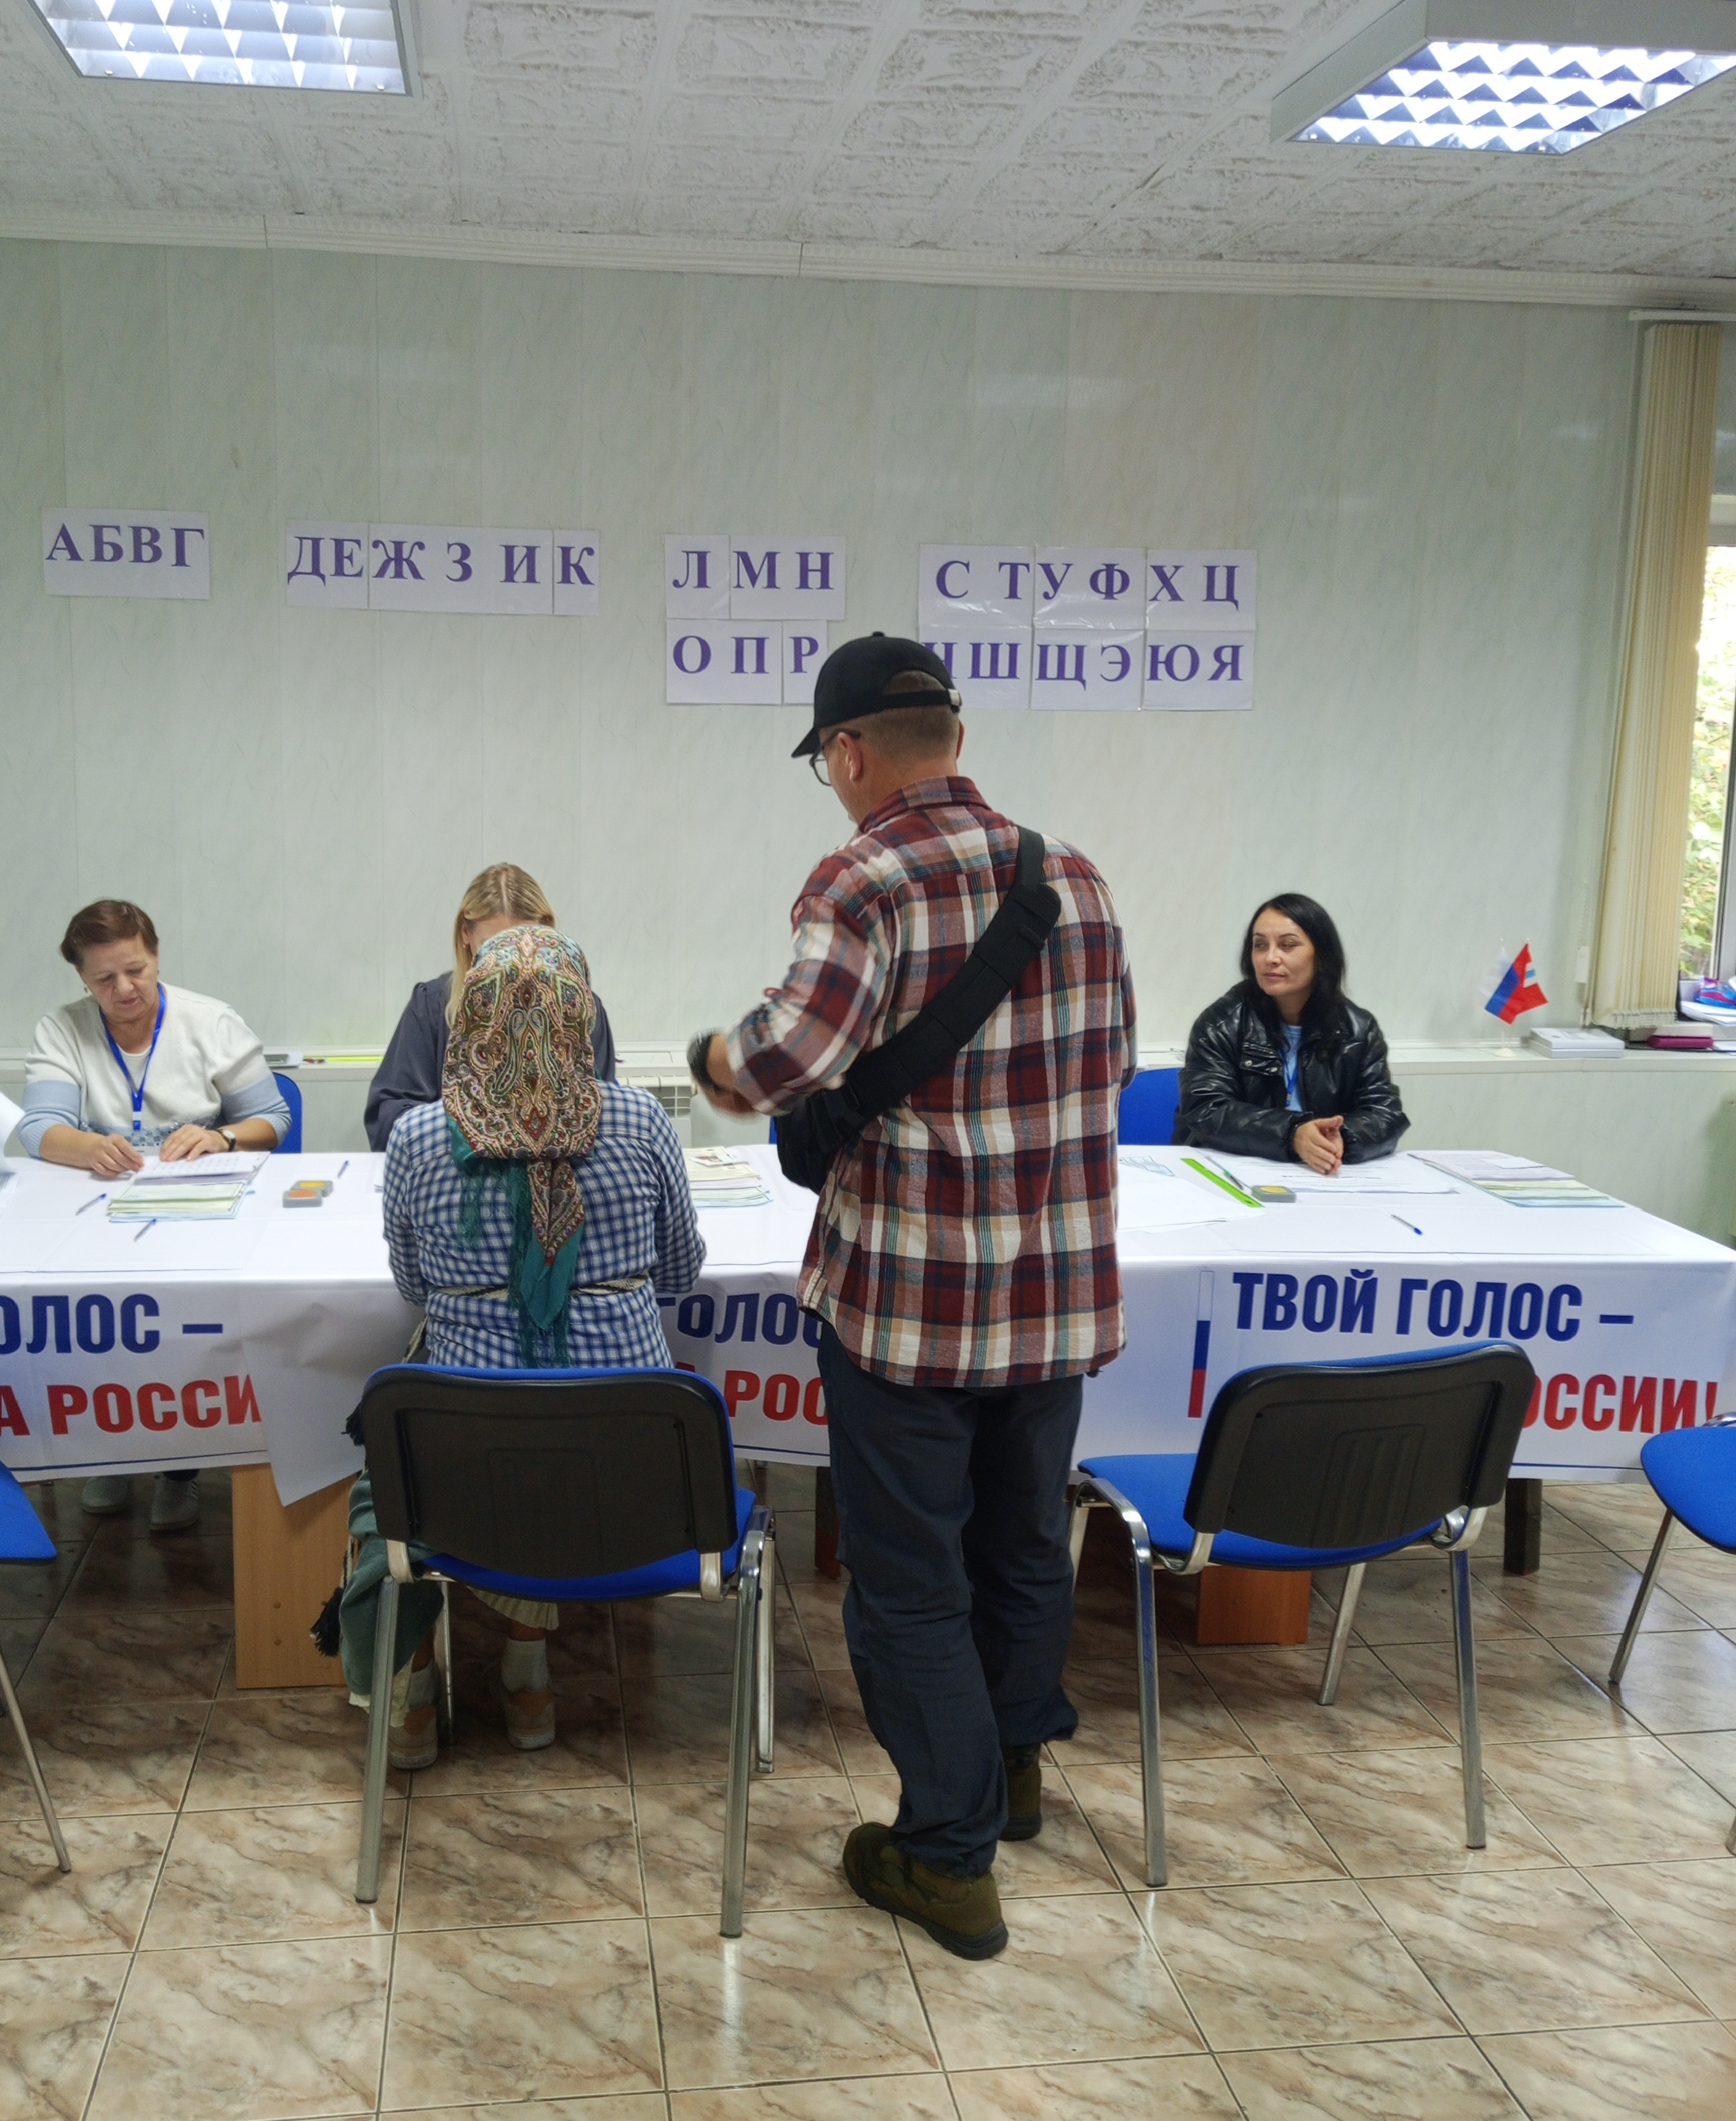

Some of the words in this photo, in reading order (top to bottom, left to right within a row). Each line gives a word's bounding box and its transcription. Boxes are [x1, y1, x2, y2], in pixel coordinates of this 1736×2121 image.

[656, 1293, 823, 1349] ОЛО
[1232, 1268, 1379, 1335] ТВОЙ
[1396, 1277, 1584, 1343] ГОЛОС
